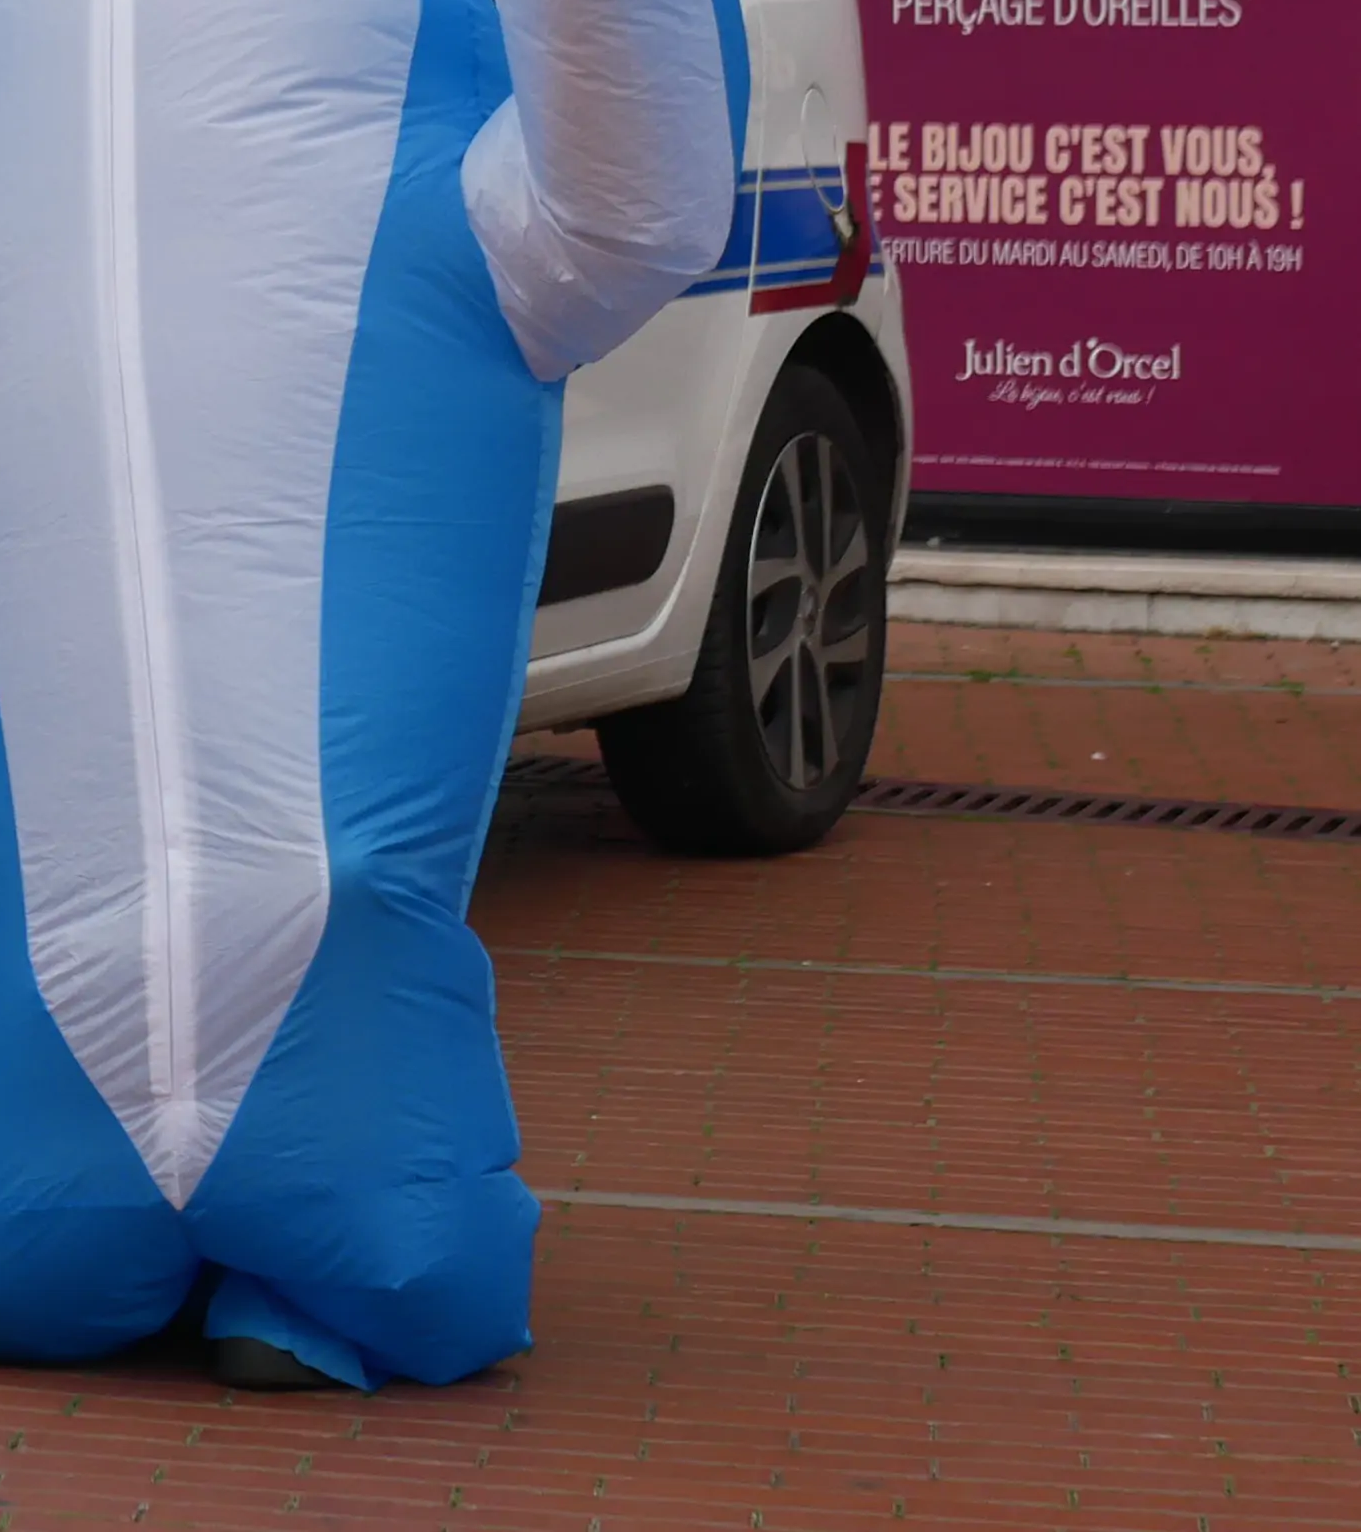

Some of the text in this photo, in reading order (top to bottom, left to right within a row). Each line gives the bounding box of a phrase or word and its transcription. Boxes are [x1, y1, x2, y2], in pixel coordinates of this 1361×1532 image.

[869, 122, 1276, 181] LE BIJOU C'EST VOUS,
[893, 173, 1049, 225] SERVICE
[1059, 176, 1165, 228] C'EST
[959, 238, 989, 266] DU
[991, 239, 1057, 267] MARDI
[1059, 240, 1089, 268] AU
[1091, 240, 1173, 273] SAMEDI,
[1175, 243, 1203, 270] DE
[1206, 243, 1244, 271] 10H
[1246, 239, 1264, 271] À
[1265, 244, 1304, 272] 19H
[956, 338, 1053, 380] Julien
